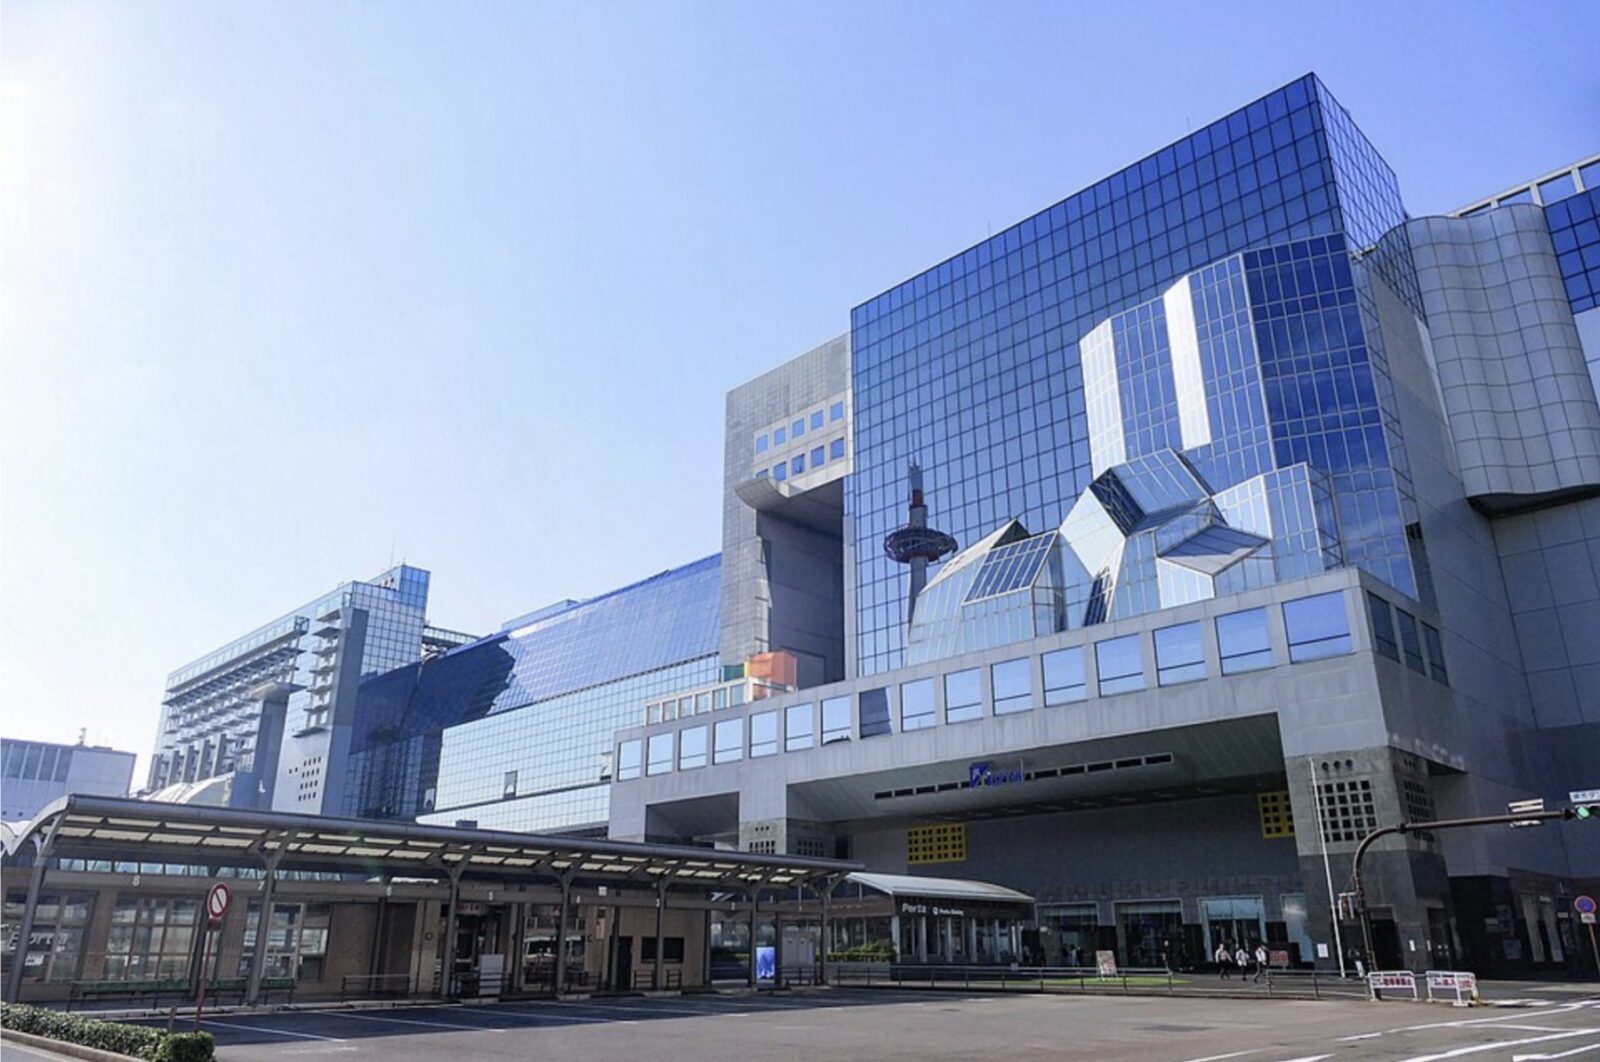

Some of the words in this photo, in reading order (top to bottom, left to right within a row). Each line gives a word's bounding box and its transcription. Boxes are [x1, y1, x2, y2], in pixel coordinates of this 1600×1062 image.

[132, 875, 140, 886] 8
[258, 880, 265, 890] 7
[902, 902, 927, 914] Porta
